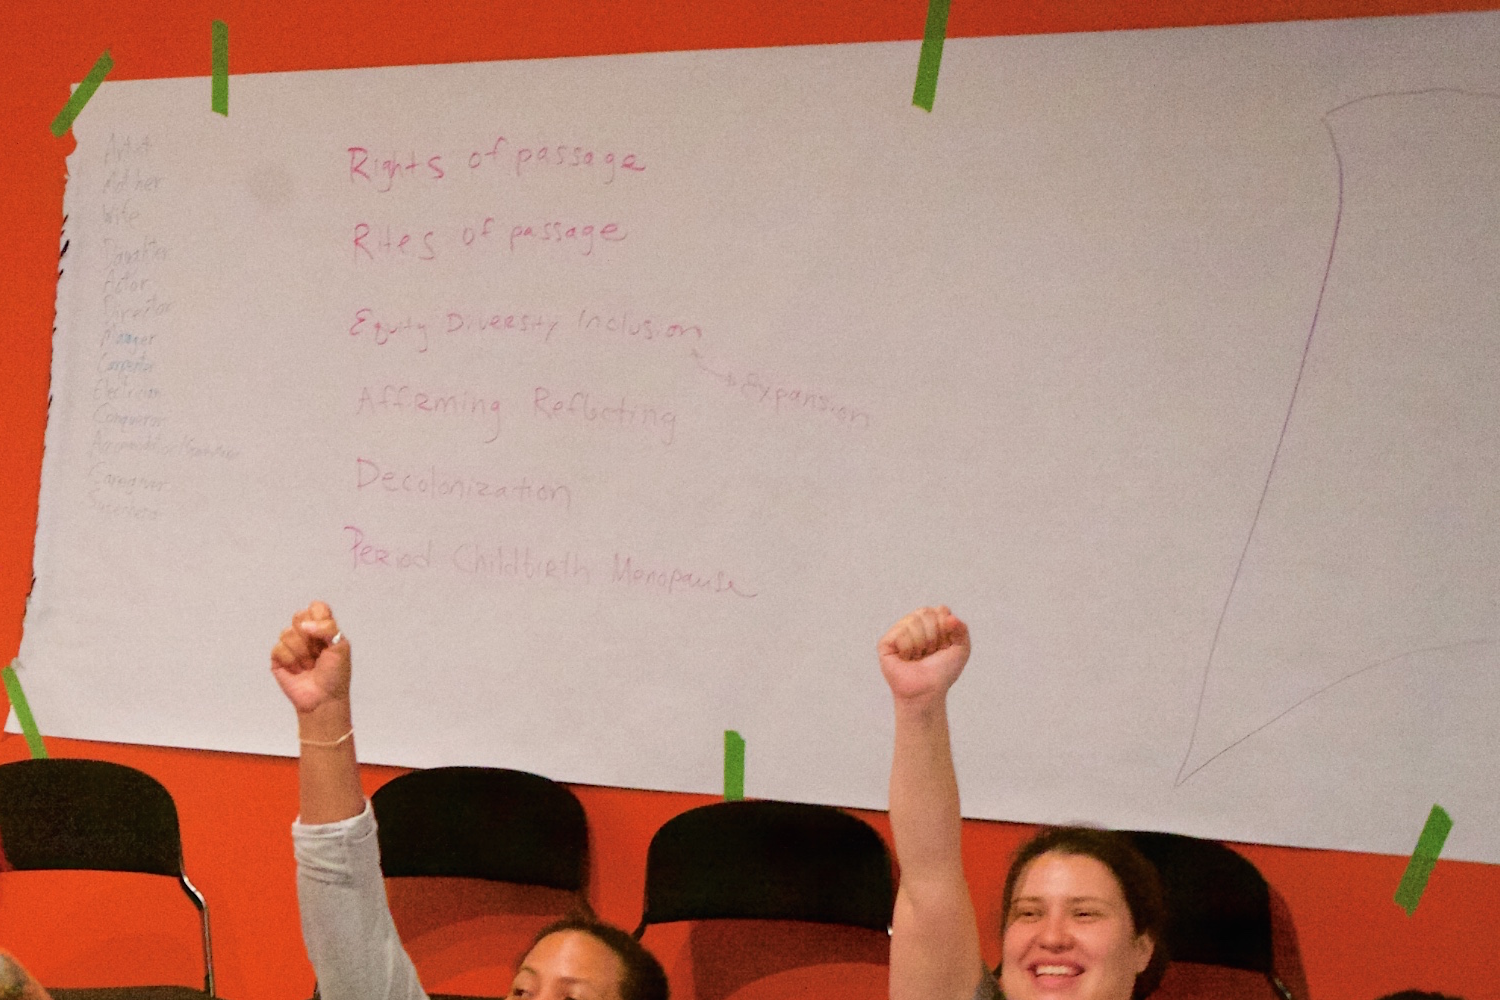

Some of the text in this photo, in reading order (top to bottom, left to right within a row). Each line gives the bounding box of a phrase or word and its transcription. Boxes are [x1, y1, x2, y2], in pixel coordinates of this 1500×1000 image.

[346, 136, 647, 193] Rights of passage
[352, 216, 628, 263] Rites of passage
[348, 307, 429, 354] Equity
[577, 307, 704, 341] Inclusion
[533, 385, 678, 447] Reflecting
[739, 371, 872, 430] Expansion
[354, 456, 574, 510] Decolonization
[342, 524, 434, 572] Period
[611, 551, 760, 599] Menopause
